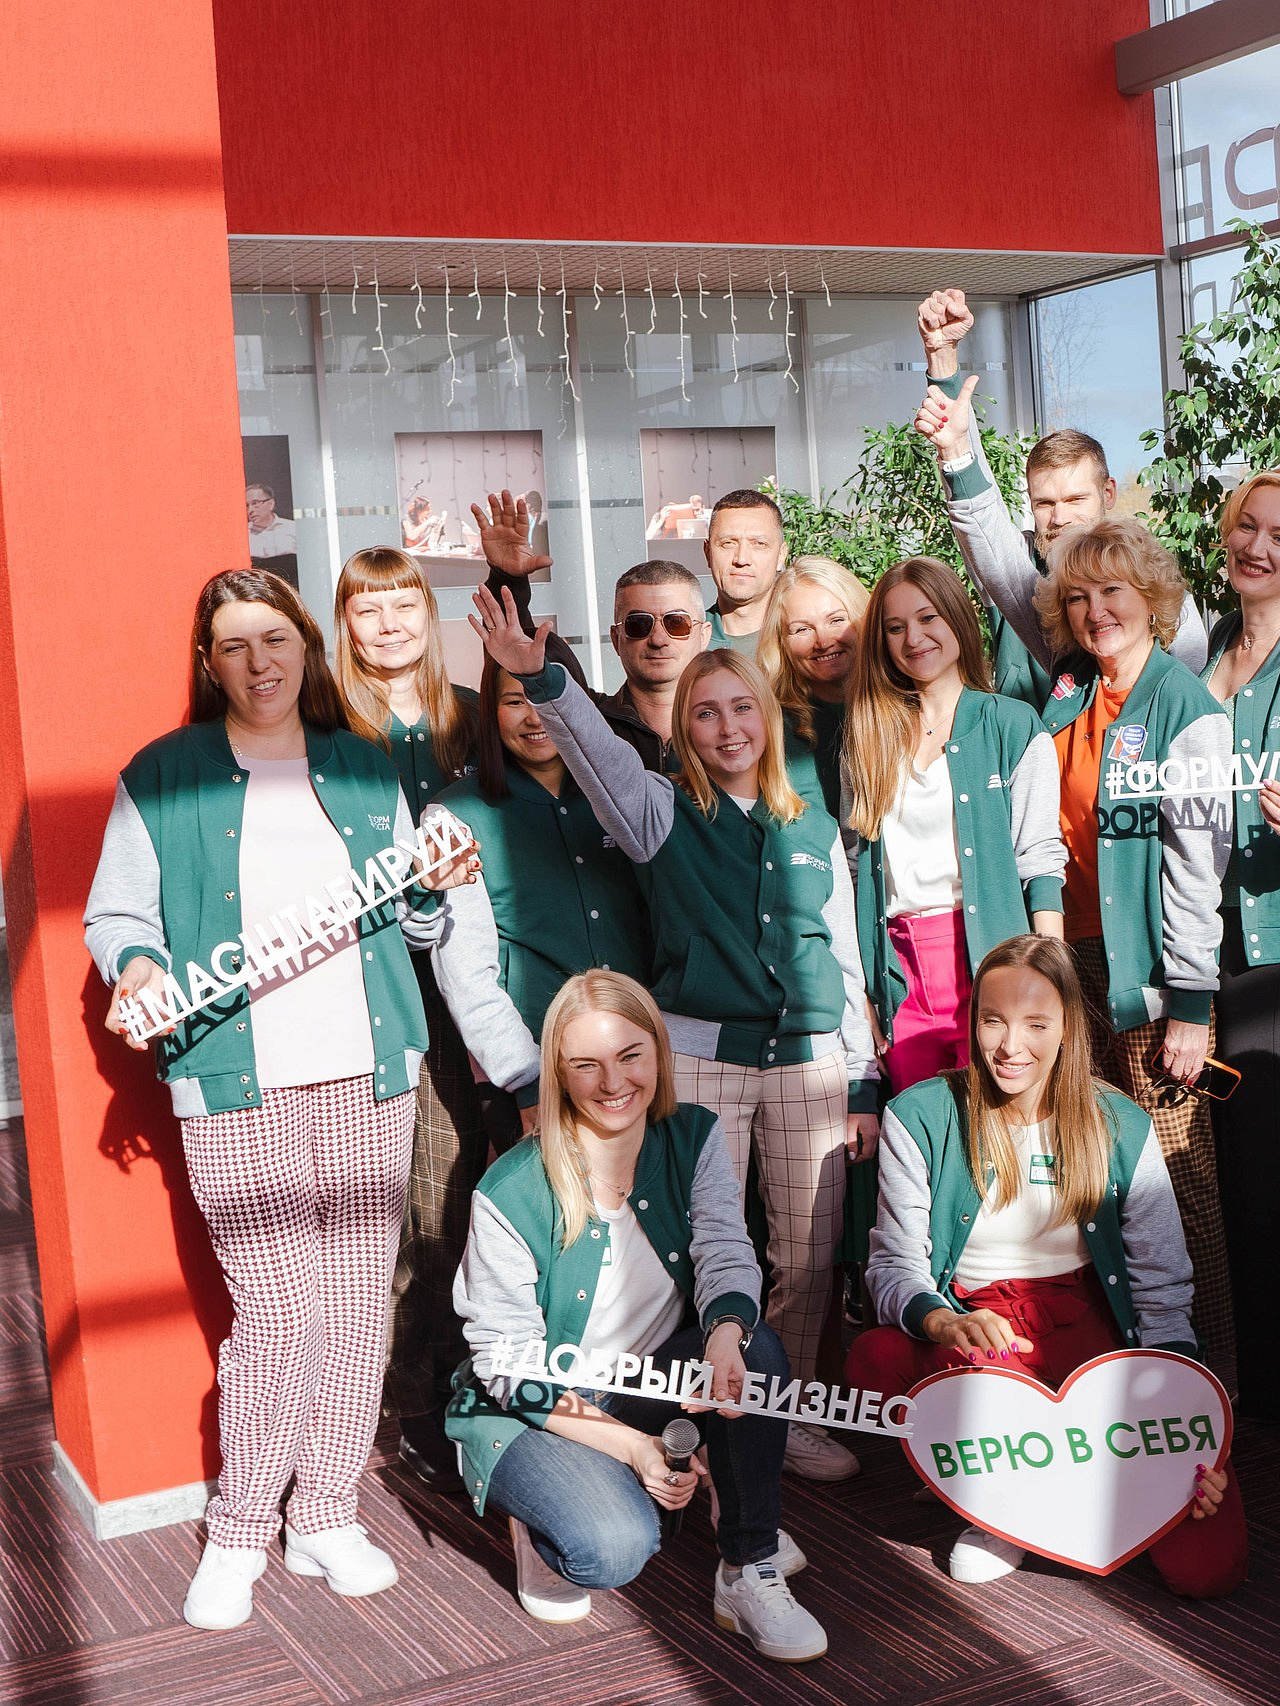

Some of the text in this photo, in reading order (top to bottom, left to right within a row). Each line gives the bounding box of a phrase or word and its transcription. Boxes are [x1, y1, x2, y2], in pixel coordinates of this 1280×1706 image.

[117, 810, 475, 1042] #МАСШТАБИРУЙ
[931, 1414, 1217, 1479] ВЕРЮ В СЕБЯ
